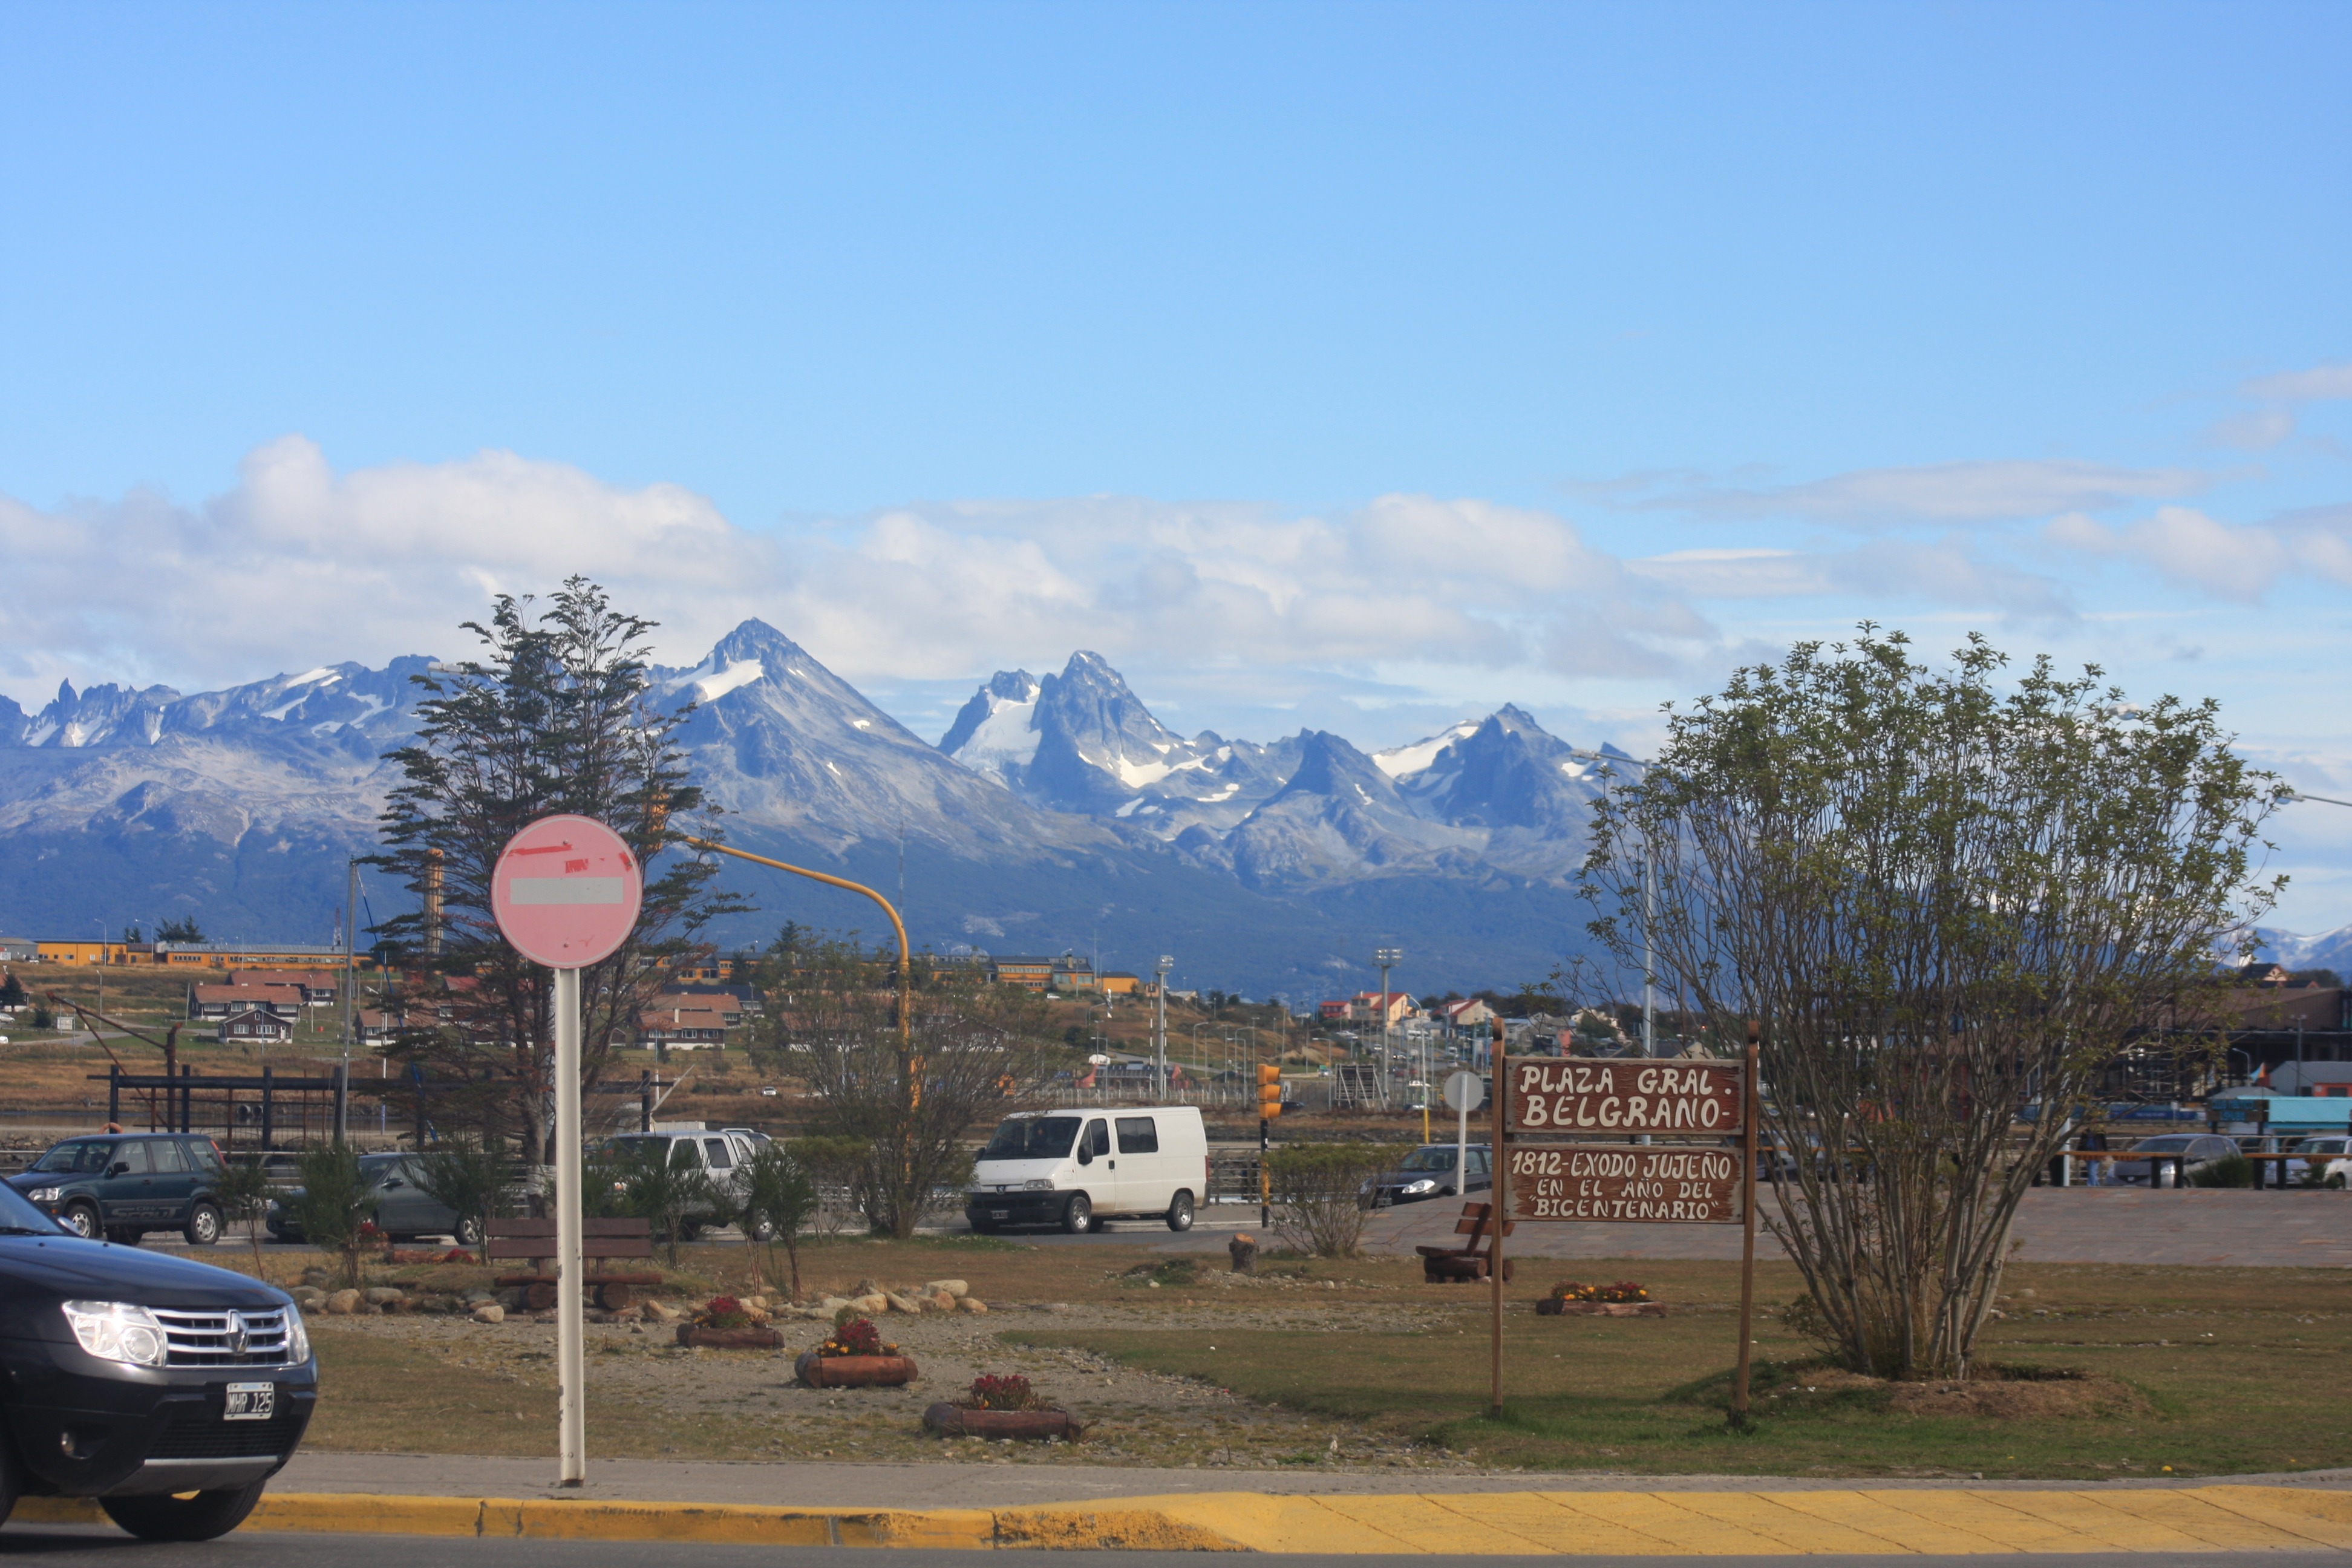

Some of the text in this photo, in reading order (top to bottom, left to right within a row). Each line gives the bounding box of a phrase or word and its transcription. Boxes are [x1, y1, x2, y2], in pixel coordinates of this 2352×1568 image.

[1520, 1066, 1613, 1094] PLAZA
[1643, 1152, 1731, 1180] JUJEÑO
[1537, 1178, 1713, 1199] EN EL AÑO DEL
[111, 1206, 183, 1220] SCOUT
[227, 1392, 272, 1413] MHR 125
